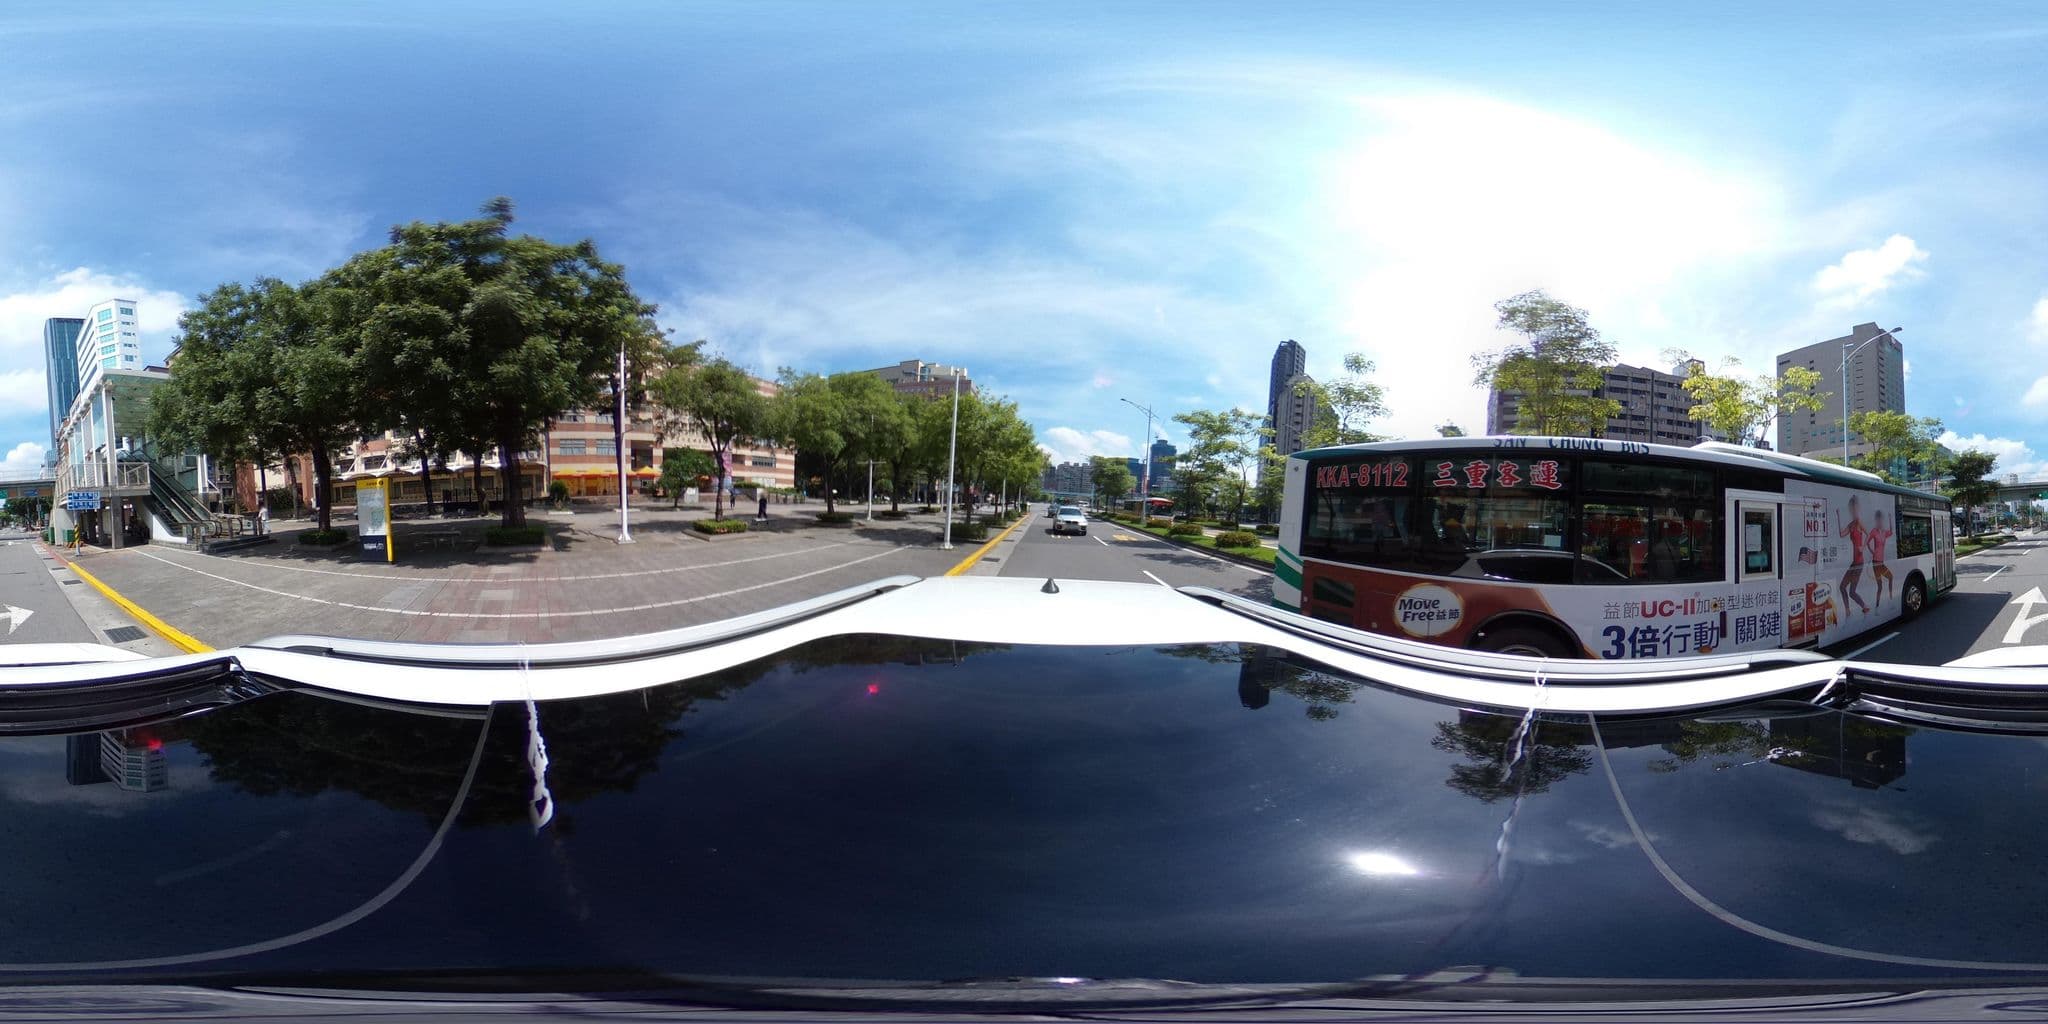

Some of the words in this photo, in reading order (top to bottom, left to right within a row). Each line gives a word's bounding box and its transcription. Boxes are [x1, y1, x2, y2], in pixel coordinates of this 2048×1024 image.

[1621, 442, 1650, 455] BUS
[1316, 463, 1409, 488] KKA-8112
[1433, 460, 1562, 490] 三重客運
[1398, 599, 1440, 611] Move
